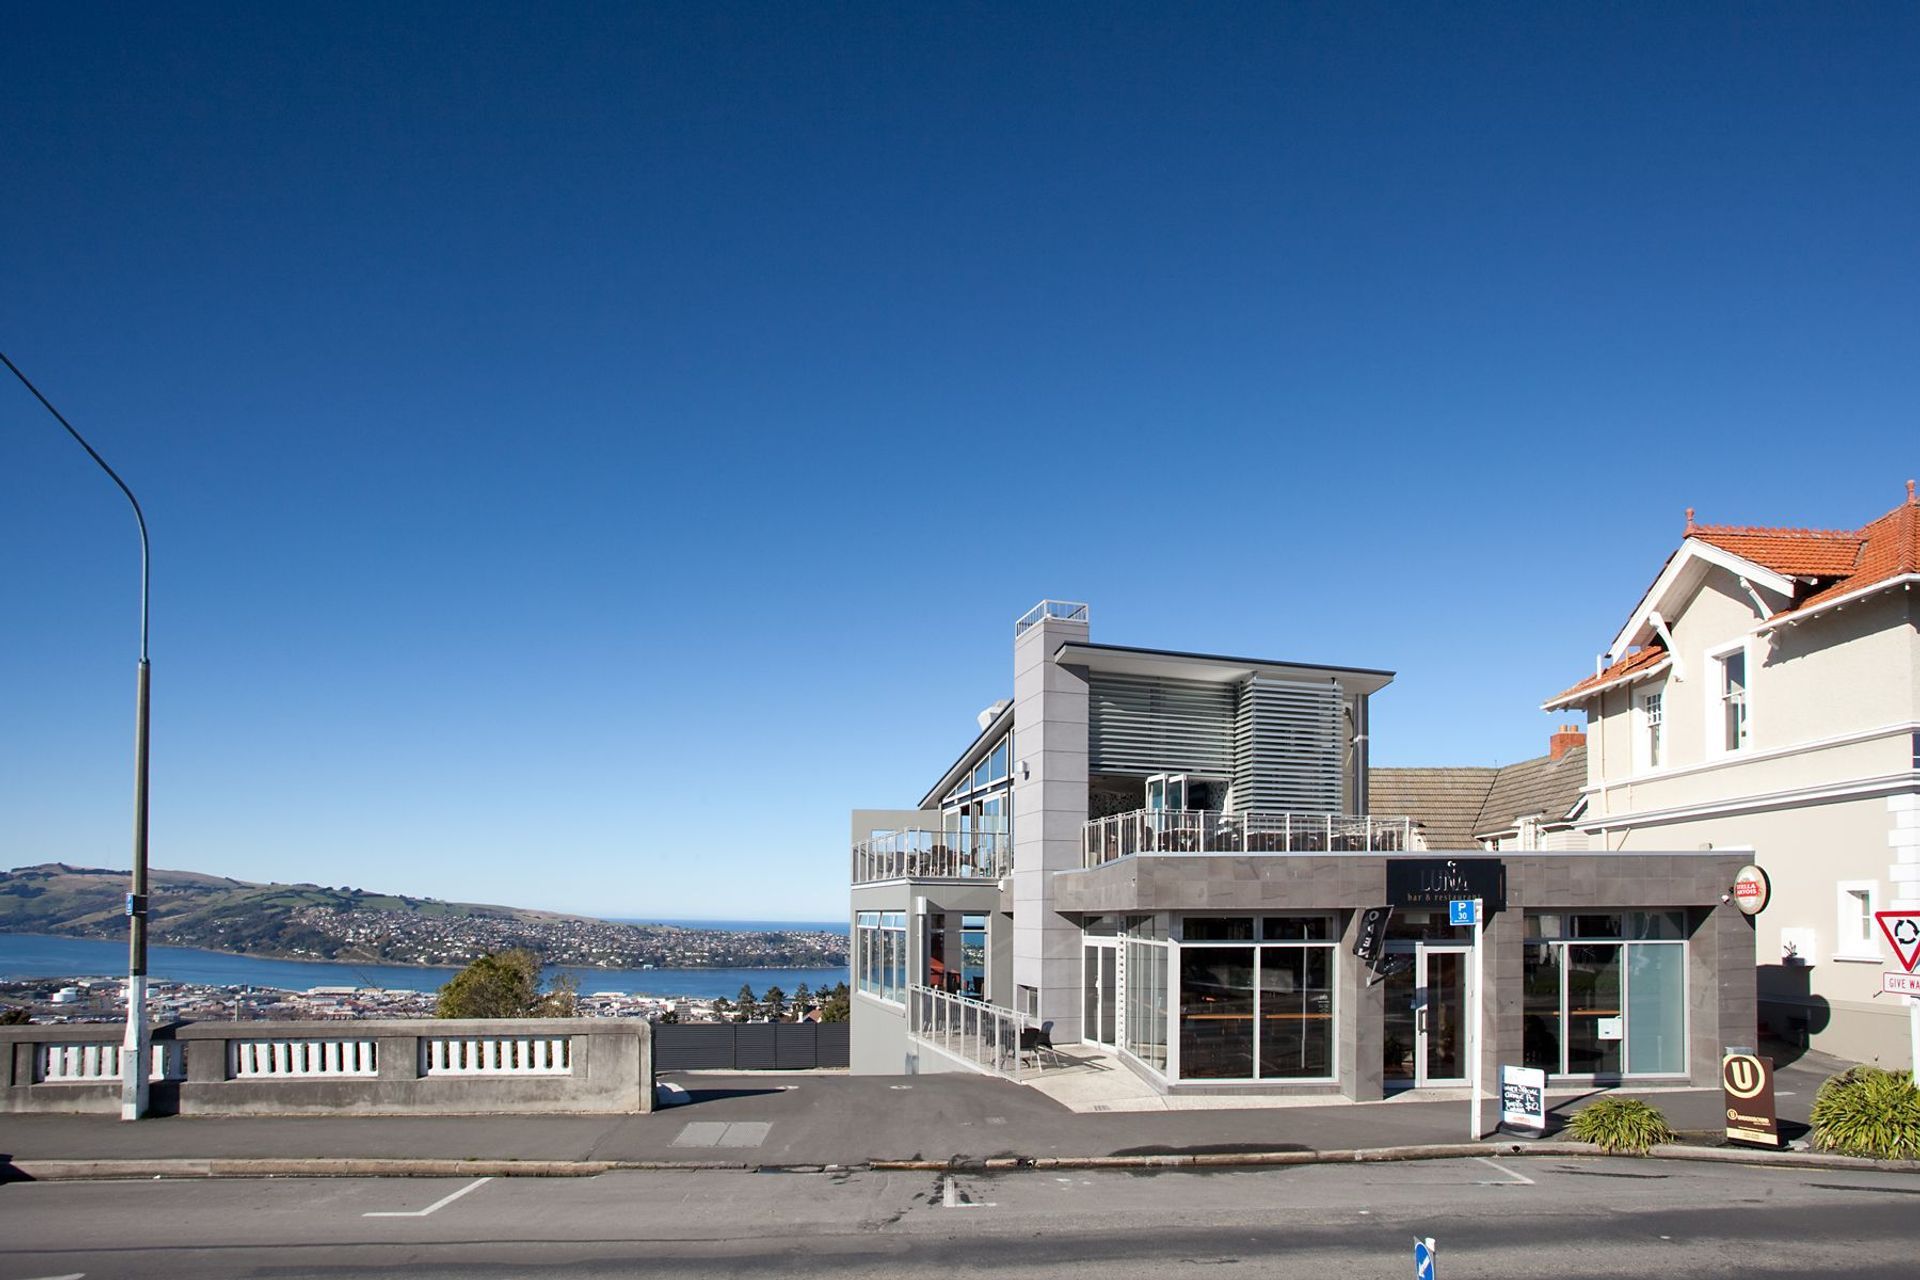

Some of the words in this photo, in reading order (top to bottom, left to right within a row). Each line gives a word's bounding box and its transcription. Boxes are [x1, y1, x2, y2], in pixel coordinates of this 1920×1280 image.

[1420, 869, 1469, 892] LUNA
[1407, 893, 1422, 901] bar
[1458, 903, 1466, 911] P
[1458, 912, 1467, 920] 30
[1889, 977, 1906, 989] GIVE
[1909, 979, 1920, 990] WA
[1731, 1061, 1753, 1090] U
